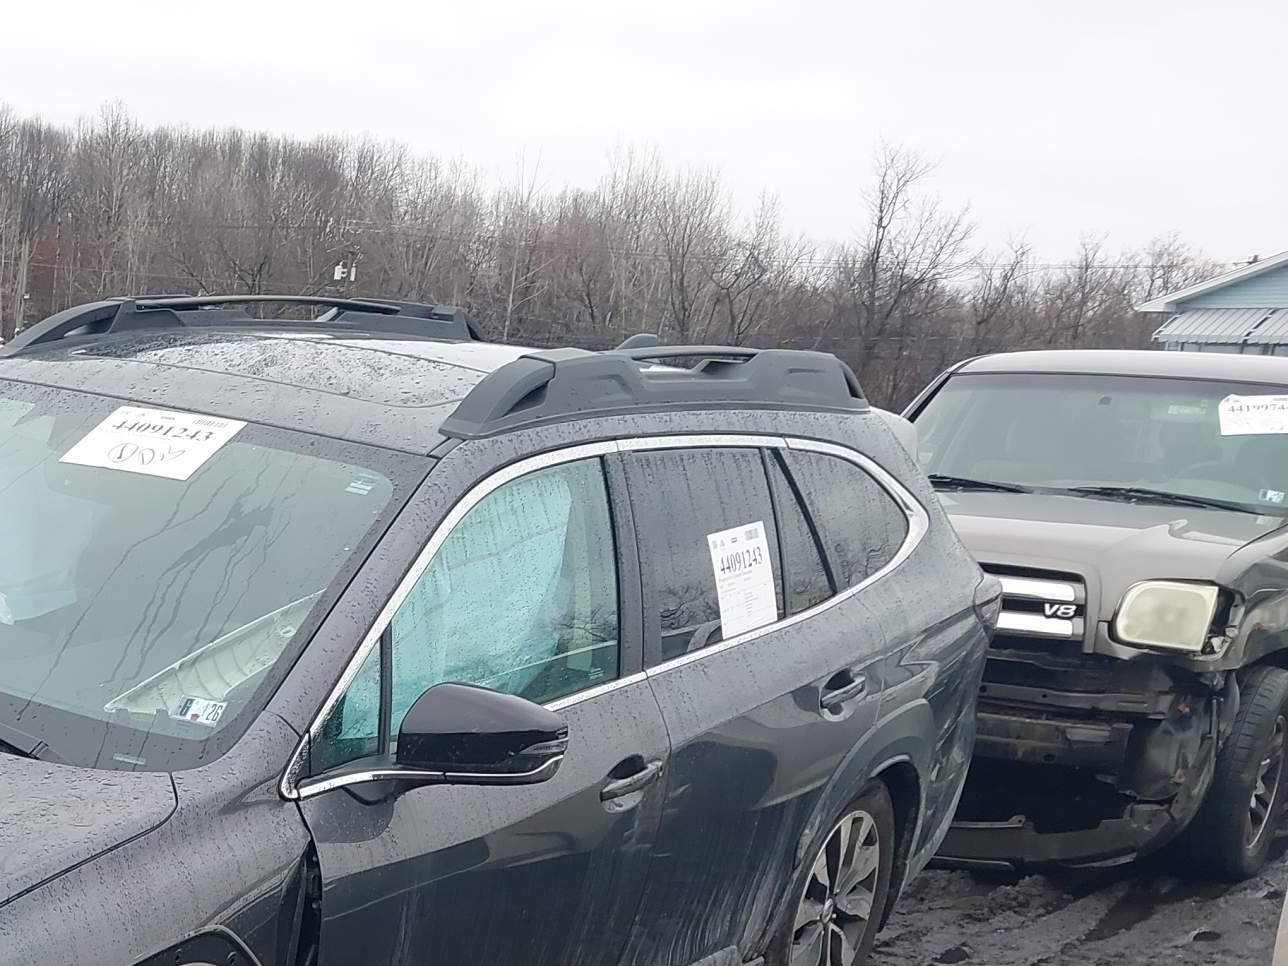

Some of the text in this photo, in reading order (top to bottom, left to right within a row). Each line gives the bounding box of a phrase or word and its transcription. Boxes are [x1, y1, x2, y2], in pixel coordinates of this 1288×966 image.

[112, 420, 214, 442] 44091243
[720, 545, 763, 575] 44091243
[1044, 603, 1077, 618] V8
